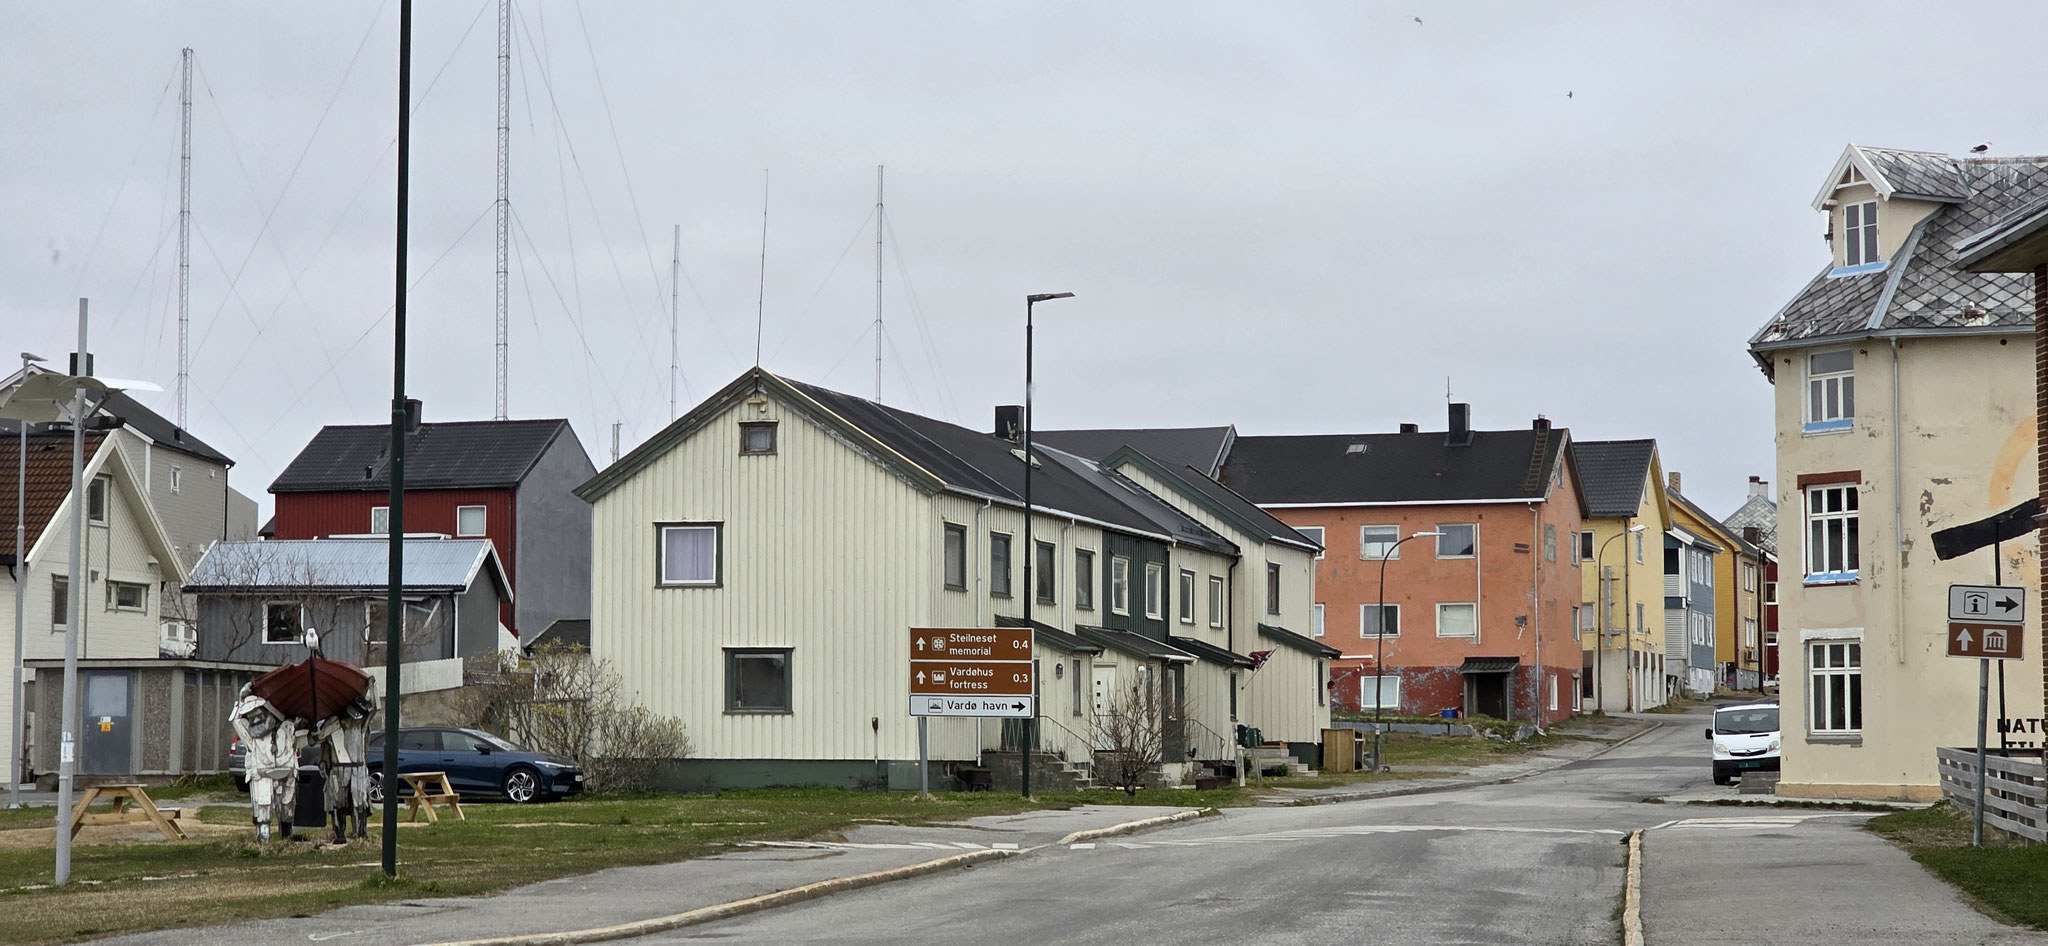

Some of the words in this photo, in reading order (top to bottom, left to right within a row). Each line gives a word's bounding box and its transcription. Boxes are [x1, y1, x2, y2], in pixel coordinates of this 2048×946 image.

[949, 633, 997, 643] Steilneset
[949, 646, 992, 656] memorial
[949, 667, 994, 677] Vardøhus
[949, 680, 988, 689] fortress
[947, 700, 977, 710] Vardø
[982, 701, 1008, 710] havn
